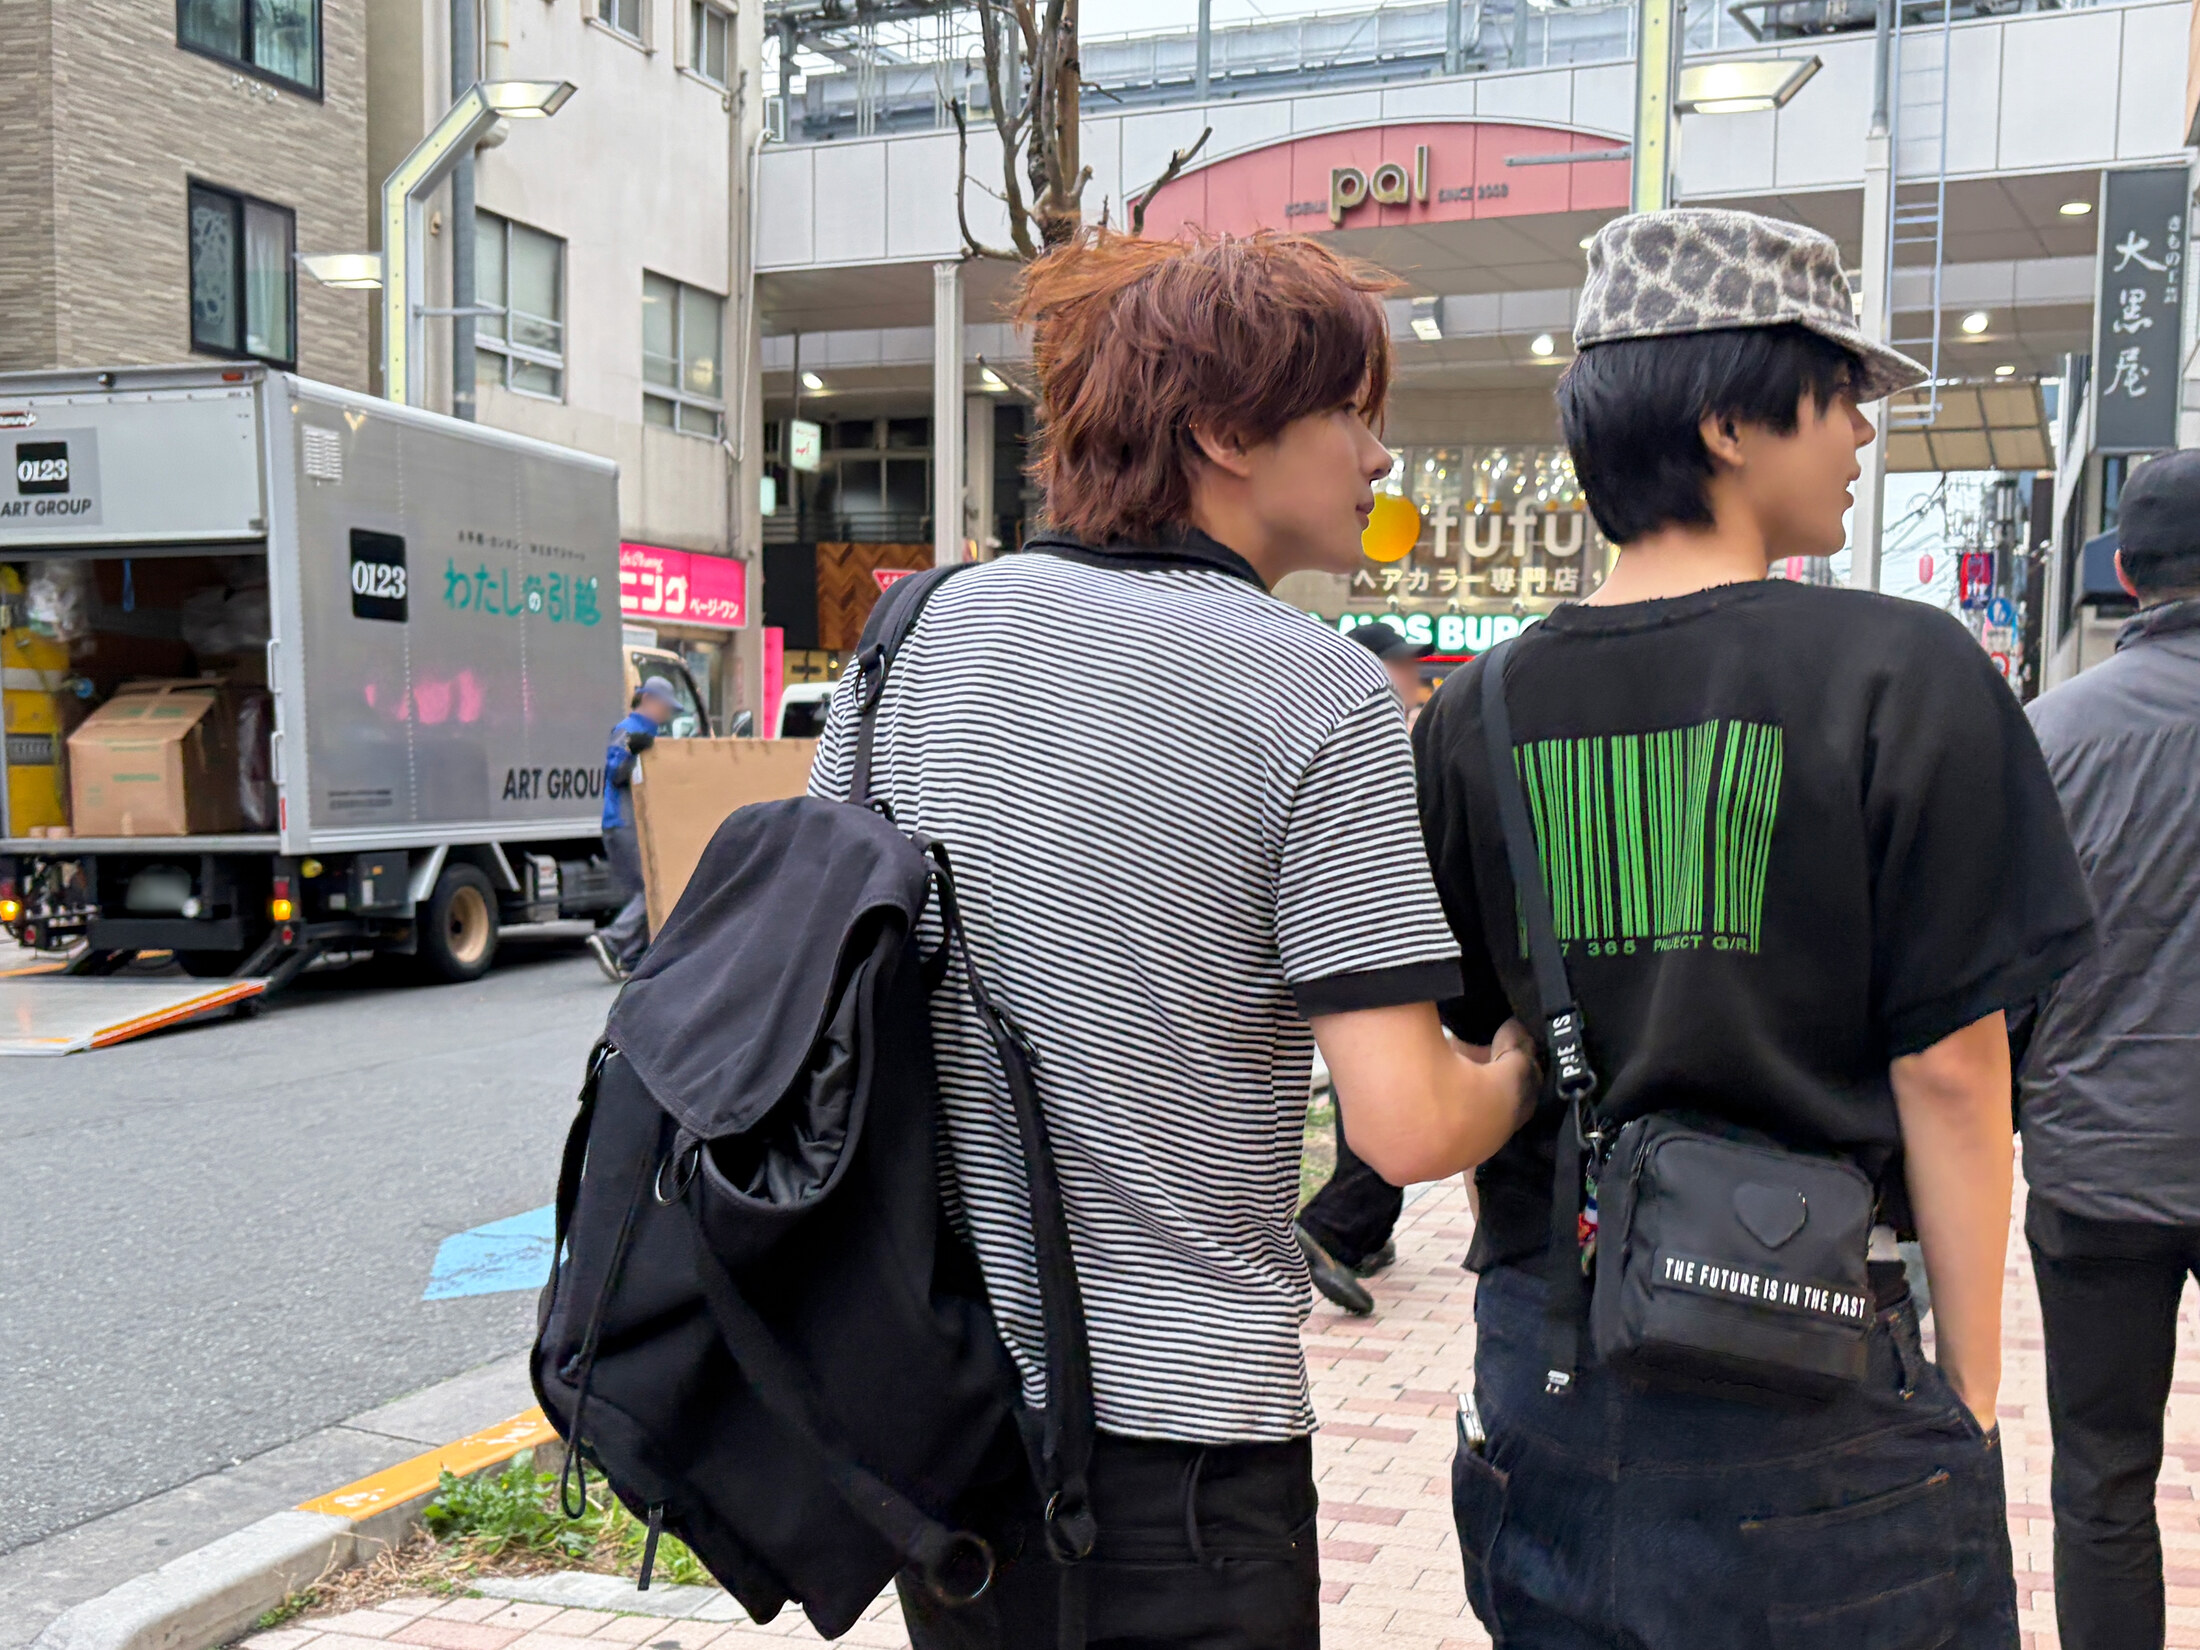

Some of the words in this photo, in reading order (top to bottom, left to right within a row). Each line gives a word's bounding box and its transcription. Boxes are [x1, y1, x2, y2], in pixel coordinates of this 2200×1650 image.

[1329, 144, 1429, 224] pal
[2103, 230, 2167, 397] 大黒屋
[18, 458, 68, 482] 0123
[1, 501, 30, 517] ART
[34, 498, 92, 516] GROUP
[352, 560, 406, 599] 0123
[1353, 567, 1579, 592] ヘアカラー専門店
[502, 766, 542, 800] ART
[547, 766, 607, 800] GROU
[1553, 1014, 1572, 1036] IS
[1665, 1257, 1695, 1284] THE
[1699, 1264, 1760, 1297] FUTURE
[1763, 1278, 1778, 1302] IS
[1782, 1282, 1800, 1305] IN
[1804, 1286, 1829, 1312] THE
[1832, 1292, 1866, 1319] PAST
